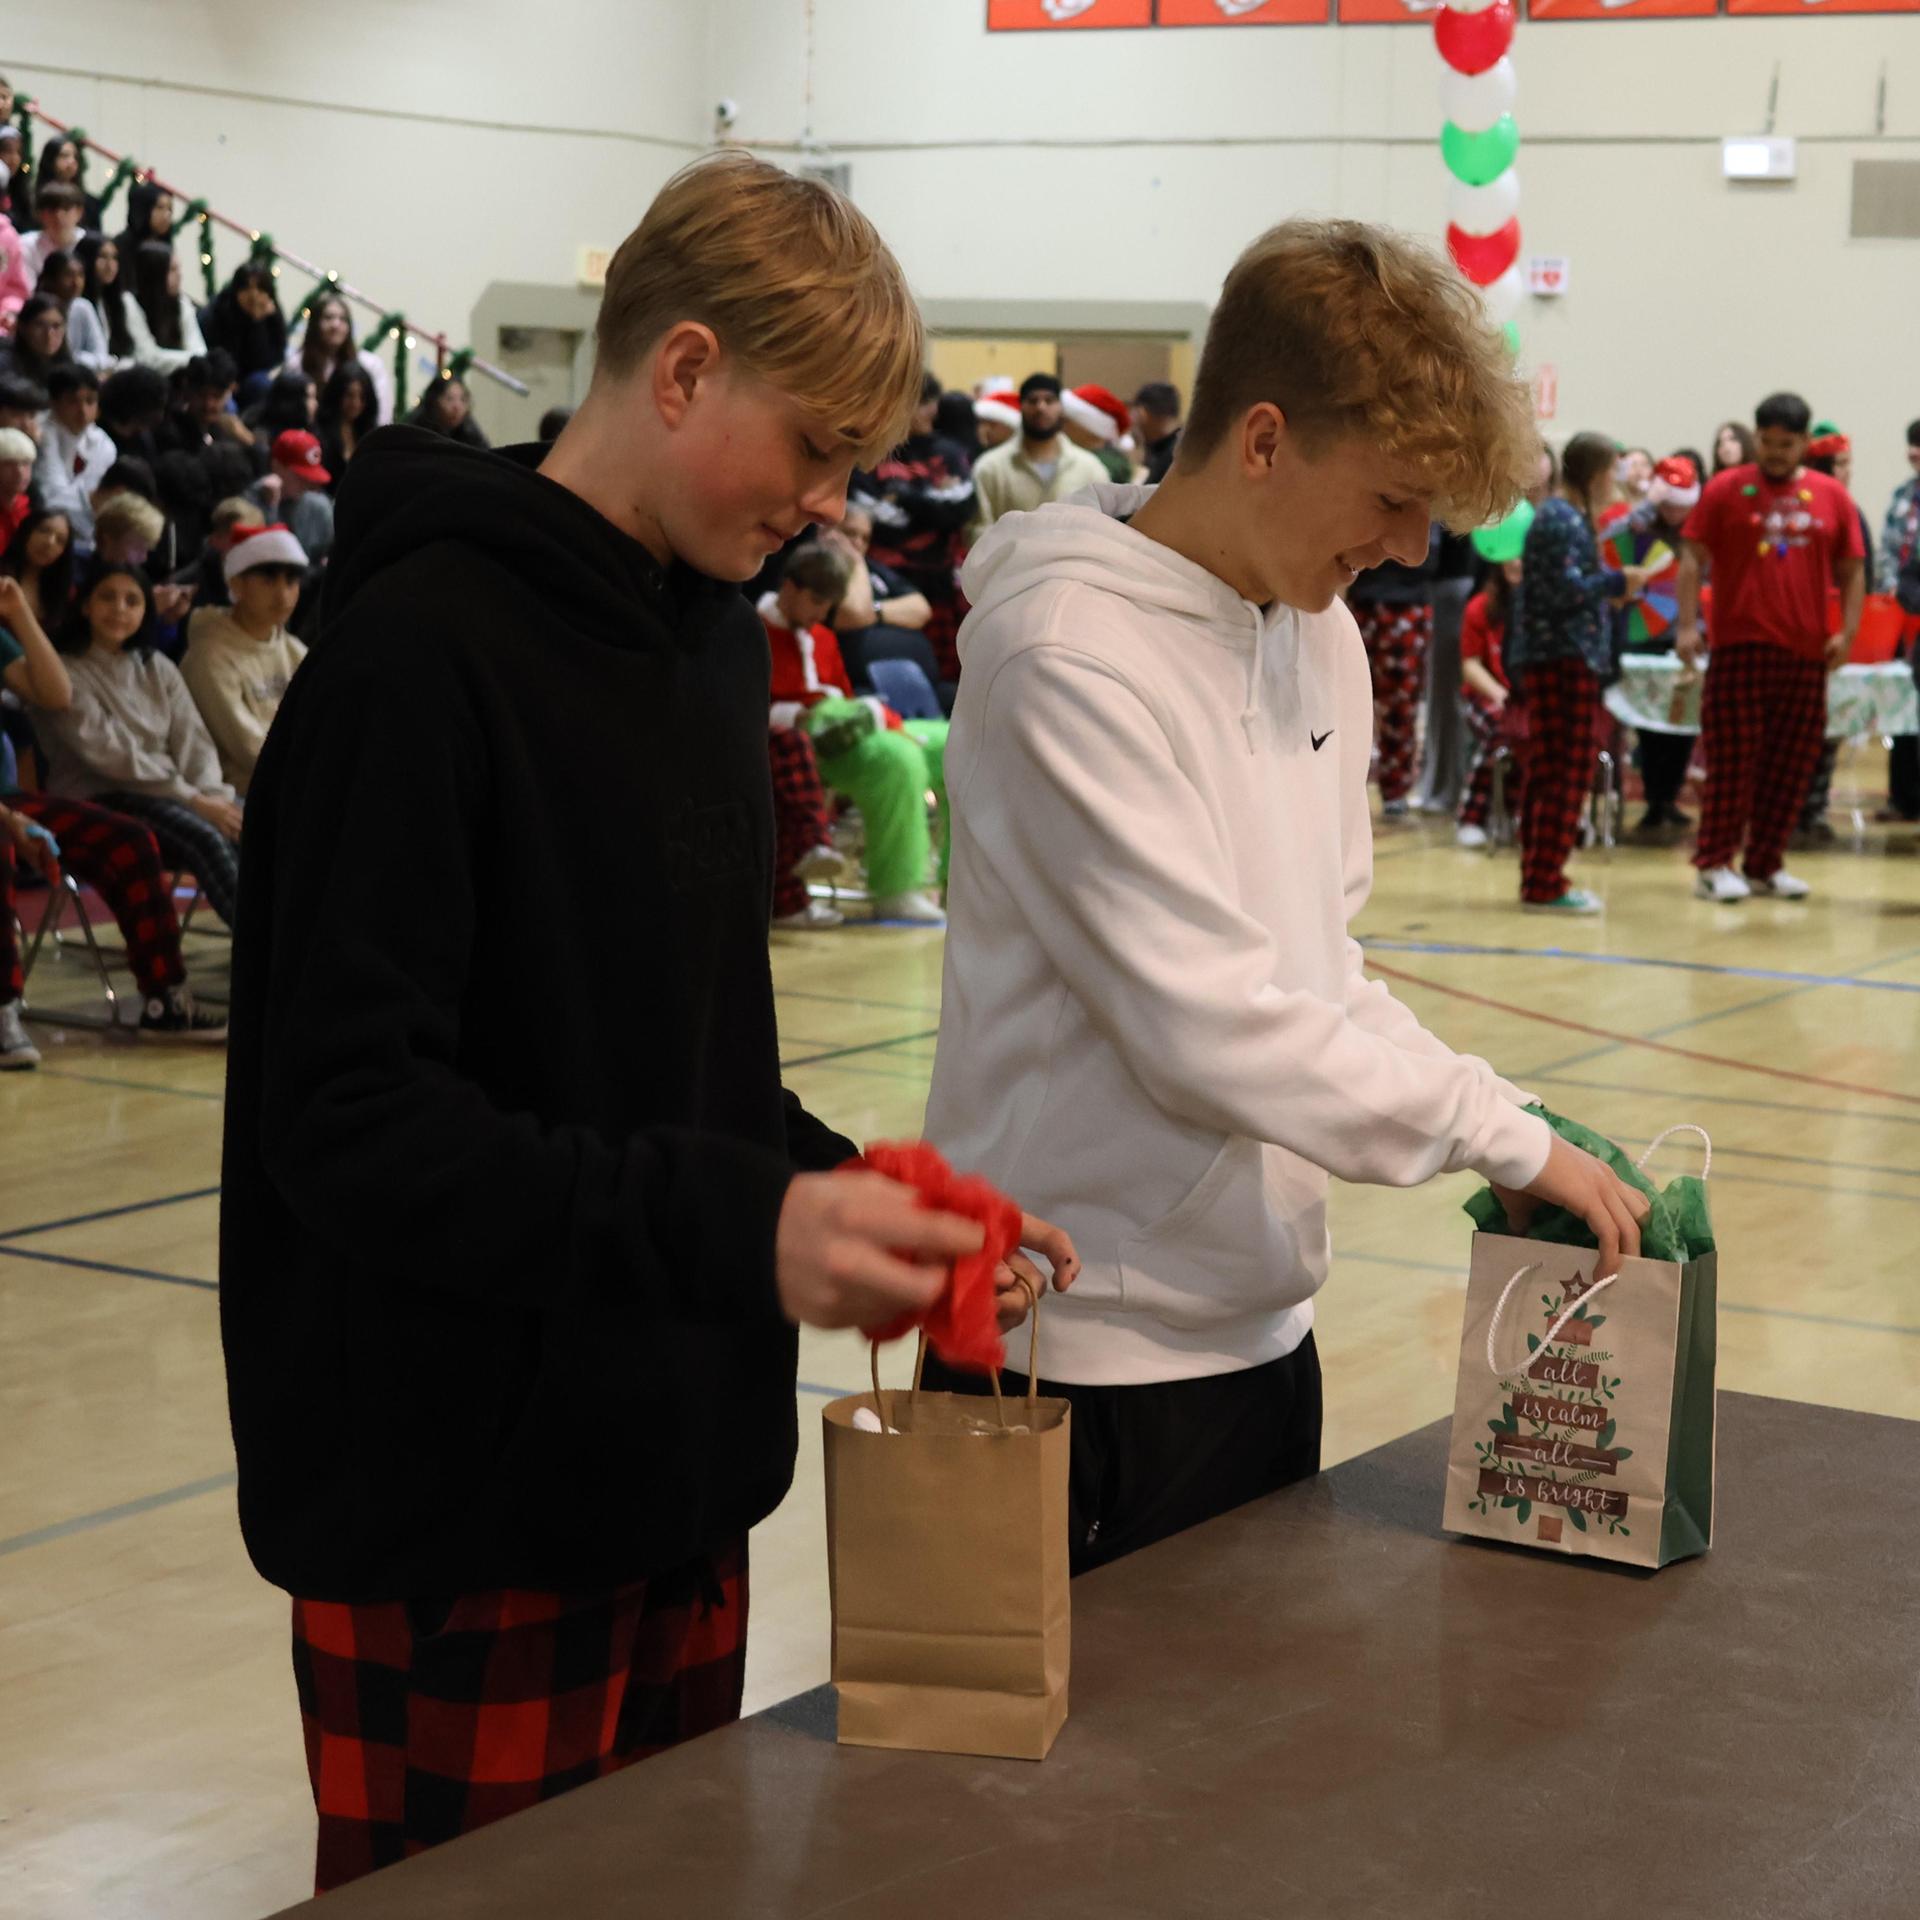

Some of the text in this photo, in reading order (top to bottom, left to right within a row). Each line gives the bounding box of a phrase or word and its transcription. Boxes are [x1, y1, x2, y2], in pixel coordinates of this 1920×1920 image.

[1543, 1360, 1587, 1384] all
[1520, 1398, 1604, 1428] is calm
[1535, 1441, 1580, 1466] all
[1503, 1476, 1619, 1510] is bright
